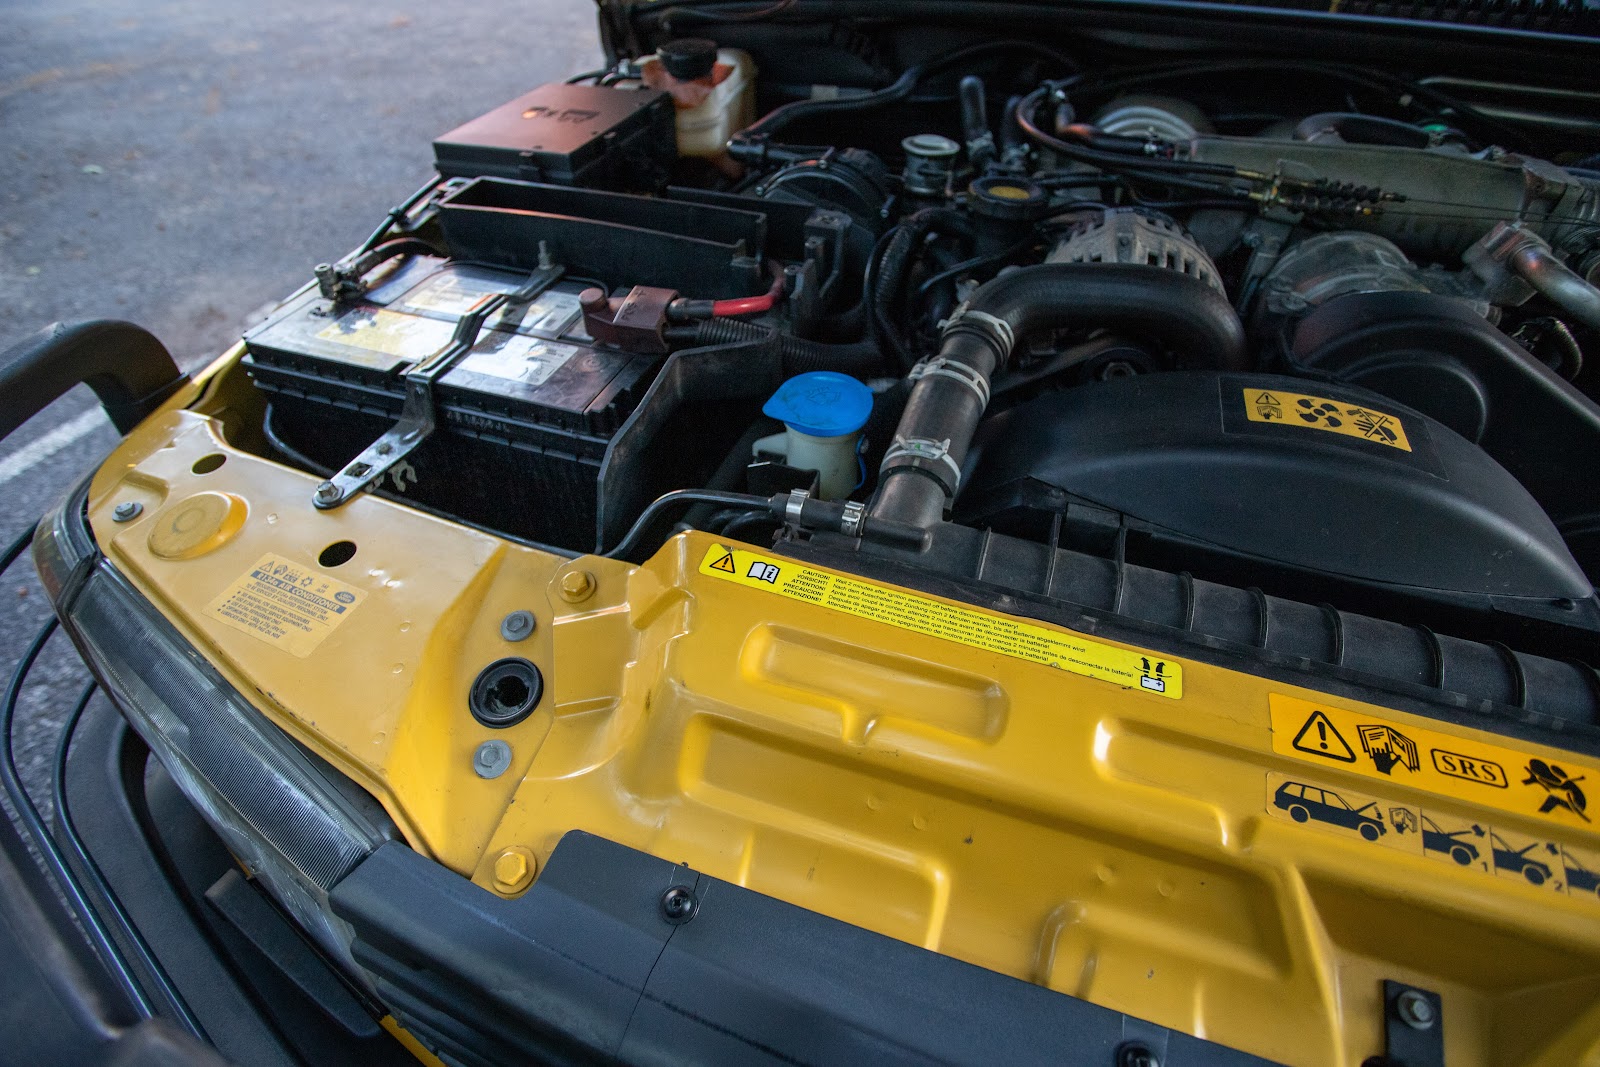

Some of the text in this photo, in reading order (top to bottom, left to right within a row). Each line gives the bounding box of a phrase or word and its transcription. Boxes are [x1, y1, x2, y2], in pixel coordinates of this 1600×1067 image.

[256, 572, 281, 586] R134a
[278, 582, 294, 592] AIR
[290, 587, 341, 612] CONDITIONER
[791, 579, 826, 591] ATTENTION!
[936, 618, 958, 626] minutes
[797, 574, 829, 586] VORSICHT!
[949, 614, 970, 623] Minuten
[802, 570, 831, 581] CAUTION!
[853, 584, 873, 592] minutes
[940, 606, 958, 614] before
[959, 611, 996, 625] disconnecting
[998, 621, 1019, 630] battery!
[826, 601, 852, 611] Attendere
[1018, 646, 1040, 654] minutos
[1442, 755, 1497, 782] SRS
[1481, 861, 1488, 872] 1
[1554, 880, 1563, 891] 2
